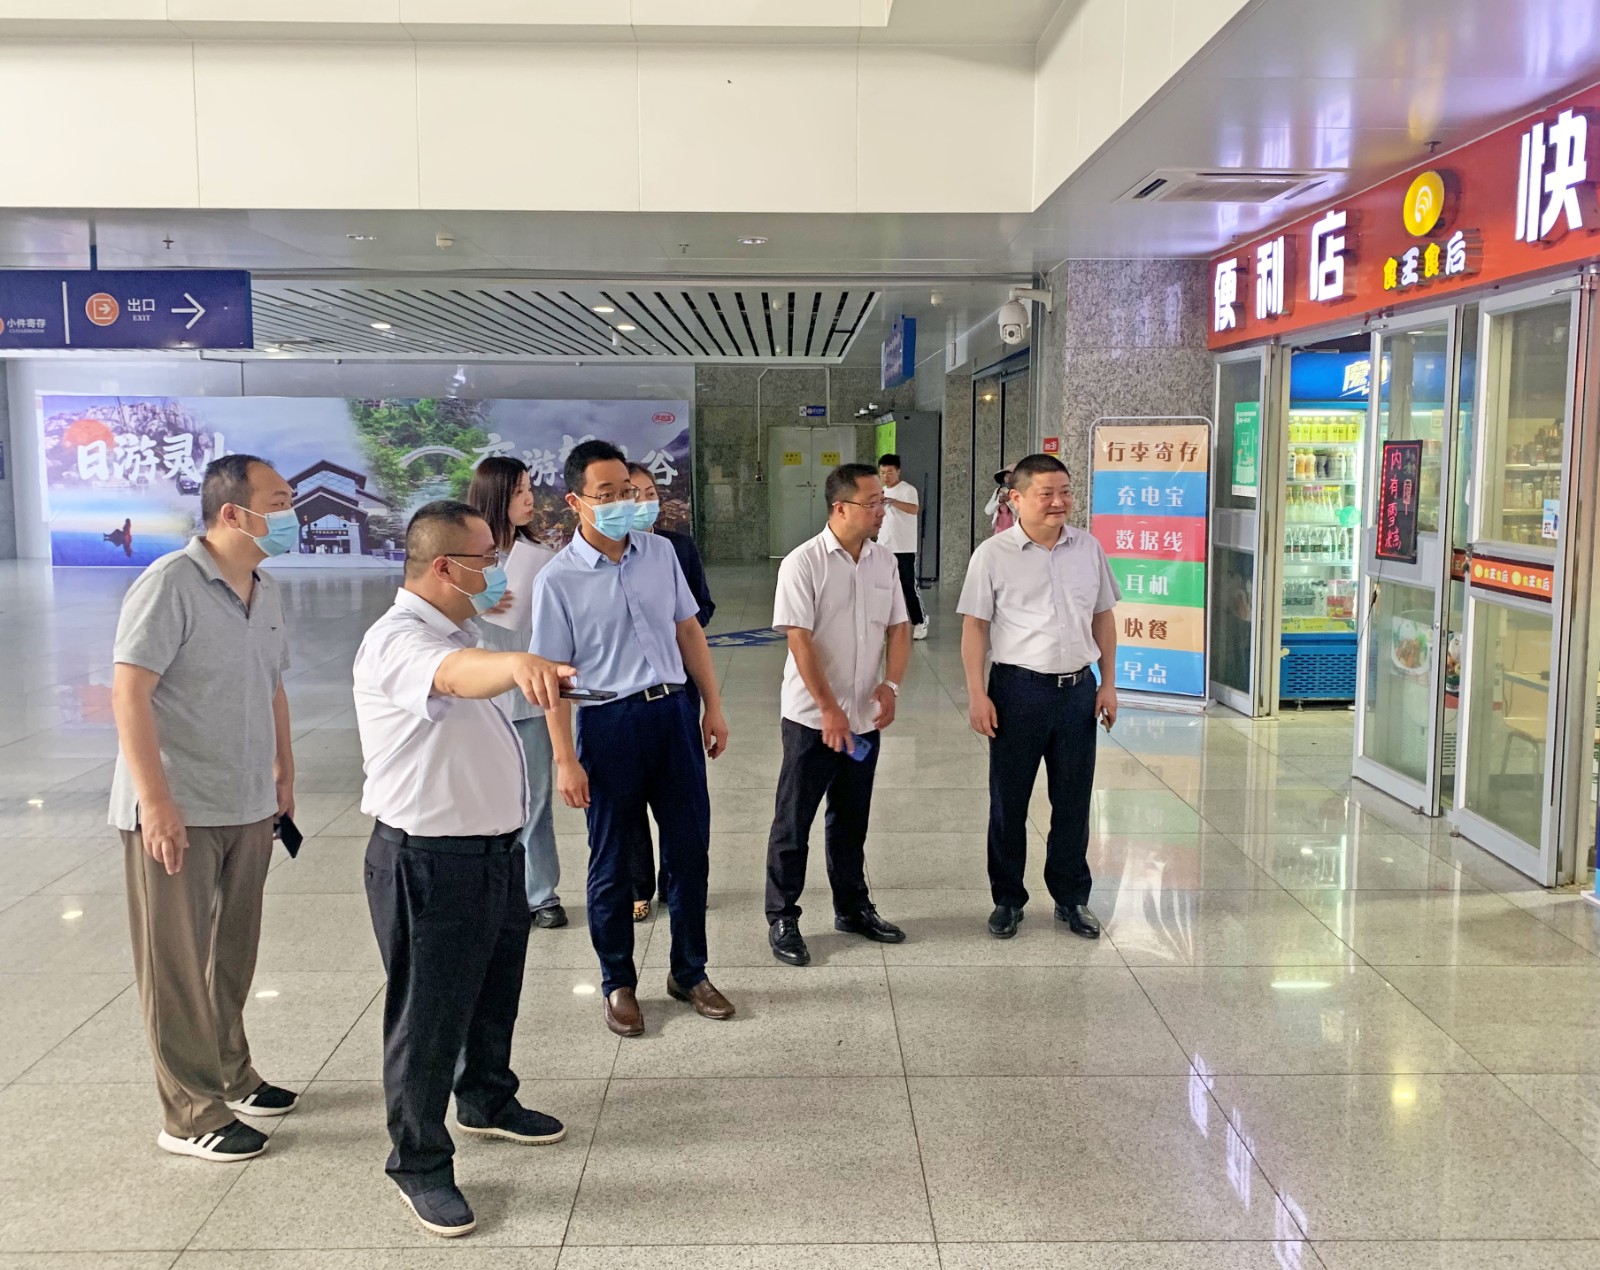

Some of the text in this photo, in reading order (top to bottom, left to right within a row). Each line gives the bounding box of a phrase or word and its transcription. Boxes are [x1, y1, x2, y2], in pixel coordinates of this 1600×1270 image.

[1515, 107, 1588, 243] 快
[1214, 209, 1347, 332] 便利店
[127, 298, 156, 312] 出口
[6, 318, 47, 329] 小件寄存
[132, 314, 151, 322] EXIT
[1107, 441, 1199, 463] 行李寄存
[1117, 485, 1185, 508] 充电宝
[1385, 449, 1402, 551] 内有雪糕
[1116, 529, 1184, 553] 数据线
[1125, 573, 1169, 596] 耳机
[1124, 617, 1168, 641] 快餐
[1122, 660, 1168, 685] 早点
